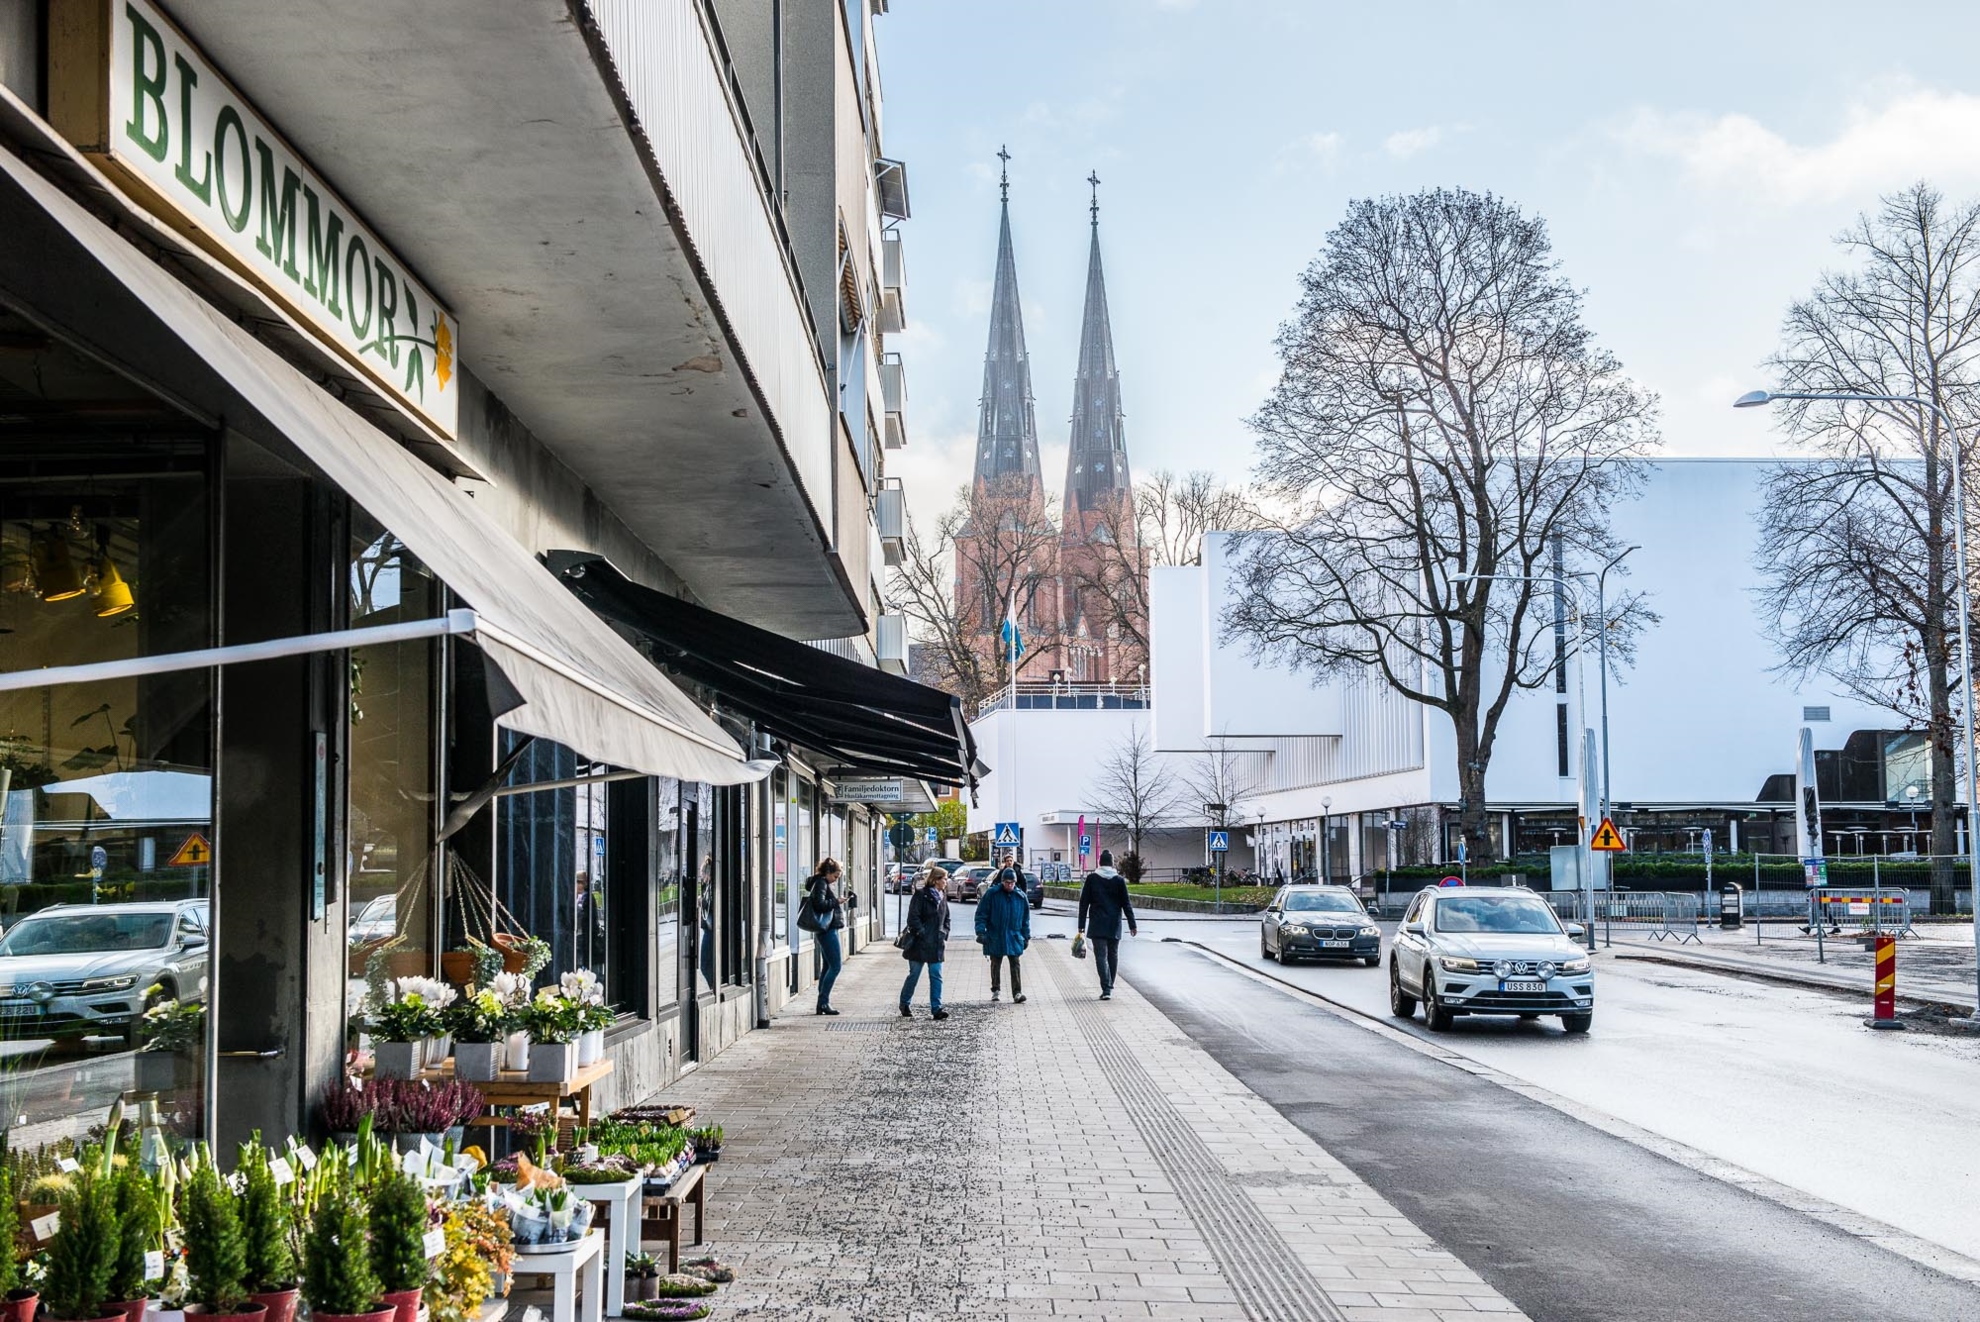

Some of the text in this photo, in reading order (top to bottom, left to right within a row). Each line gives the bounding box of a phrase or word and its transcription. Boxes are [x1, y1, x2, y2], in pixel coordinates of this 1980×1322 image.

[126, 6, 400, 370] BLOMMOR
[844, 784, 899, 793] Familjedoktorn
[1083, 836, 1089, 845] P
[1507, 983, 1543, 991] USS 830
